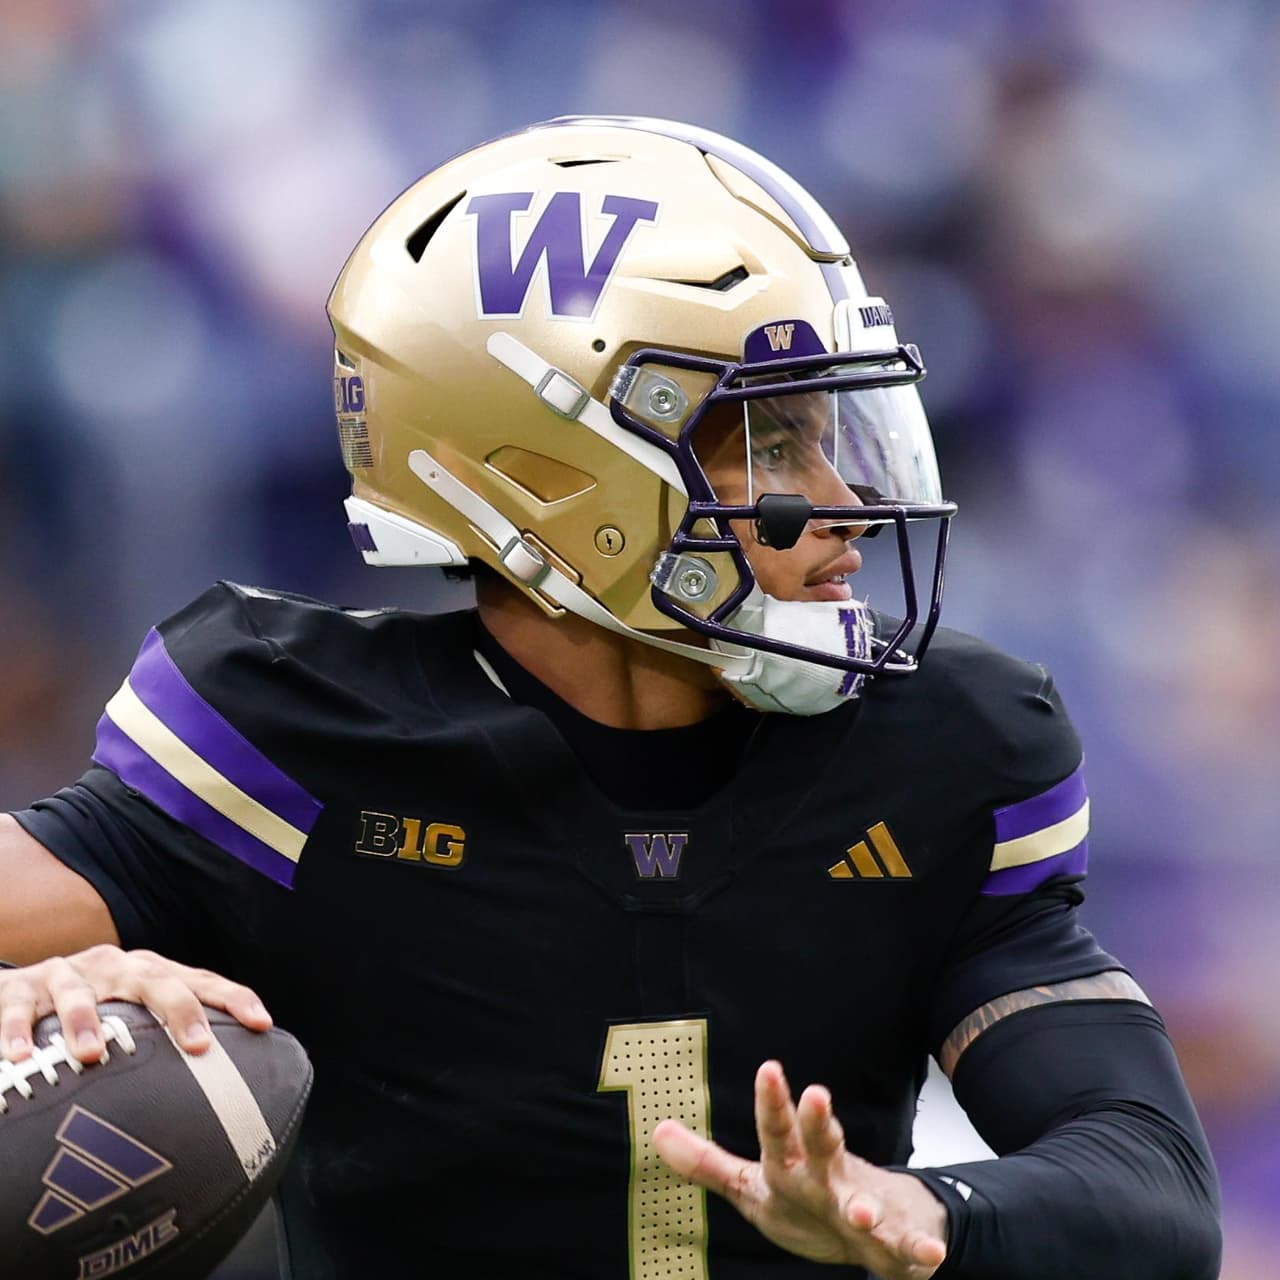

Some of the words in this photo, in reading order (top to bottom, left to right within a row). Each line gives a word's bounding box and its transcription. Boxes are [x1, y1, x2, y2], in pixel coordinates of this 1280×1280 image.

[465, 191, 659, 320] W
[764, 323, 795, 351] W
[354, 810, 466, 868] BIG
[624, 832, 688, 878] W
